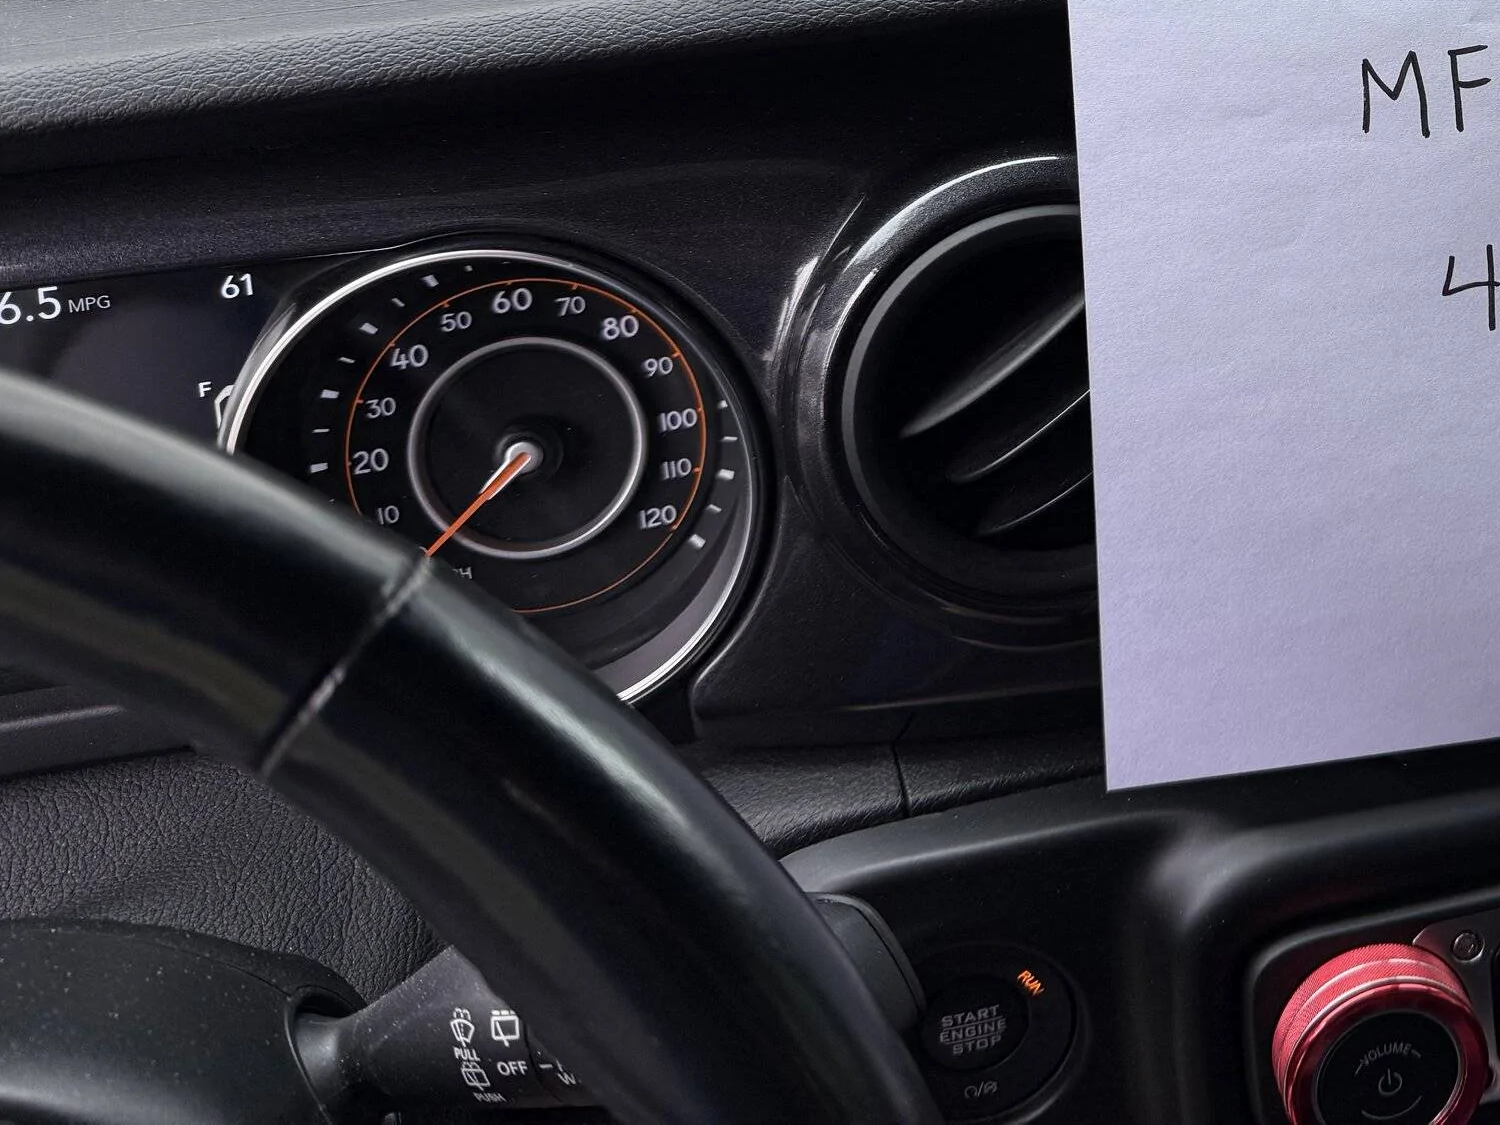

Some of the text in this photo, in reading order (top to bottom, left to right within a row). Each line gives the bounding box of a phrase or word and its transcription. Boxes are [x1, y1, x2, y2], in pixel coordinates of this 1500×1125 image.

[219, 272, 255, 300] 61
[68, 294, 112, 313] MPG
[492, 287, 533, 314] 60
[555, 296, 586, 317] 70
[441, 311, 473, 332] 50
[602, 315, 640, 340] 80
[390, 344, 429, 370] 40
[643, 356, 674, 377] 90
[197, 380, 213, 399] F
[365, 397, 397, 419] 30
[659, 408, 698, 432] 100
[352, 448, 389, 475] 20
[662, 458, 693, 480] 110
[377, 505, 400, 525] 10
[640, 505, 677, 531] 120
[1016, 970, 1045, 996] RUN
[941, 1004, 1000, 1027] START
[940, 1018, 1007, 1043] ENGINE
[452, 1046, 481, 1062] PULL
[952, 1036, 1002, 1055] STOP
[1359, 1041, 1412, 1066] VOLUME
[497, 1061, 528, 1076] OFF
[473, 1091, 507, 1103] PUSH
